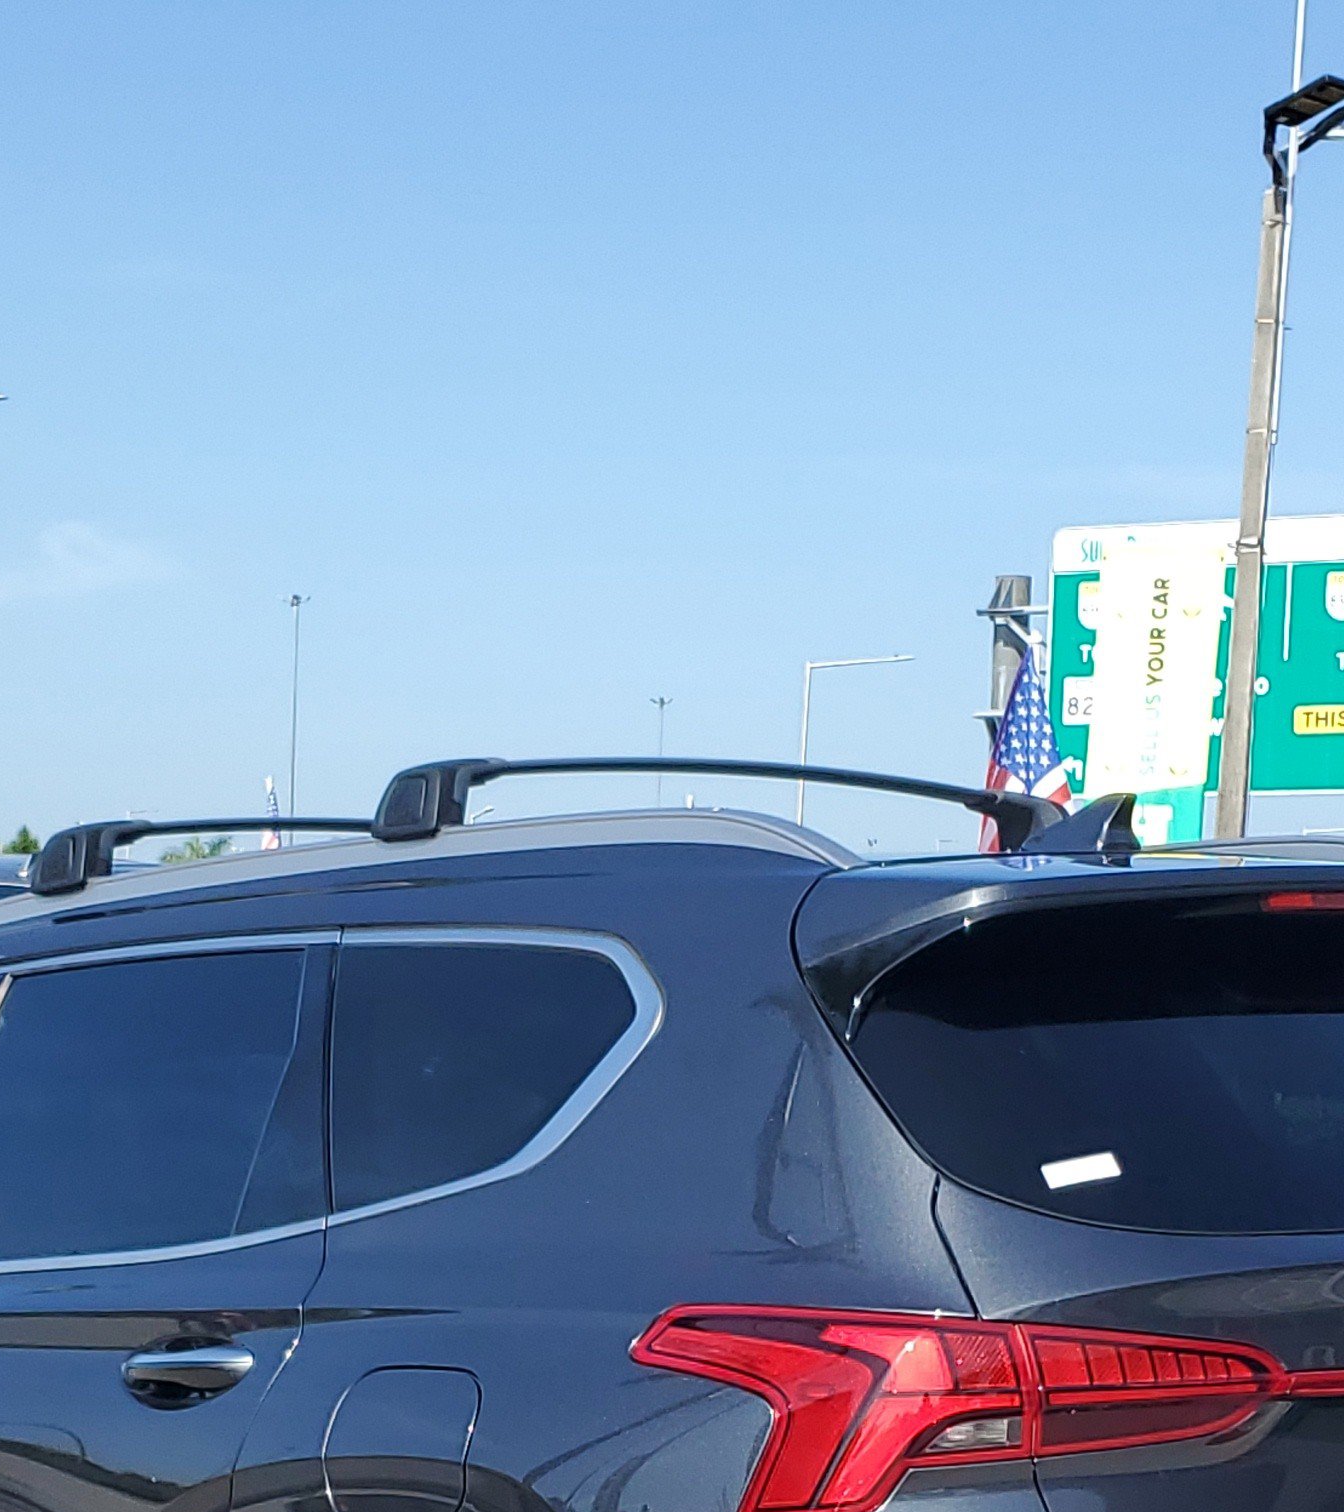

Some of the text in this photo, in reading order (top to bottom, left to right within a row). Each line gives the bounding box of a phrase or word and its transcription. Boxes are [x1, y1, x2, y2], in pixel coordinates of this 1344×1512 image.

[1081, 538, 1103, 562] SU
[1151, 577, 1170, 620] CAR
[1146, 627, 1166, 686] YOUR
